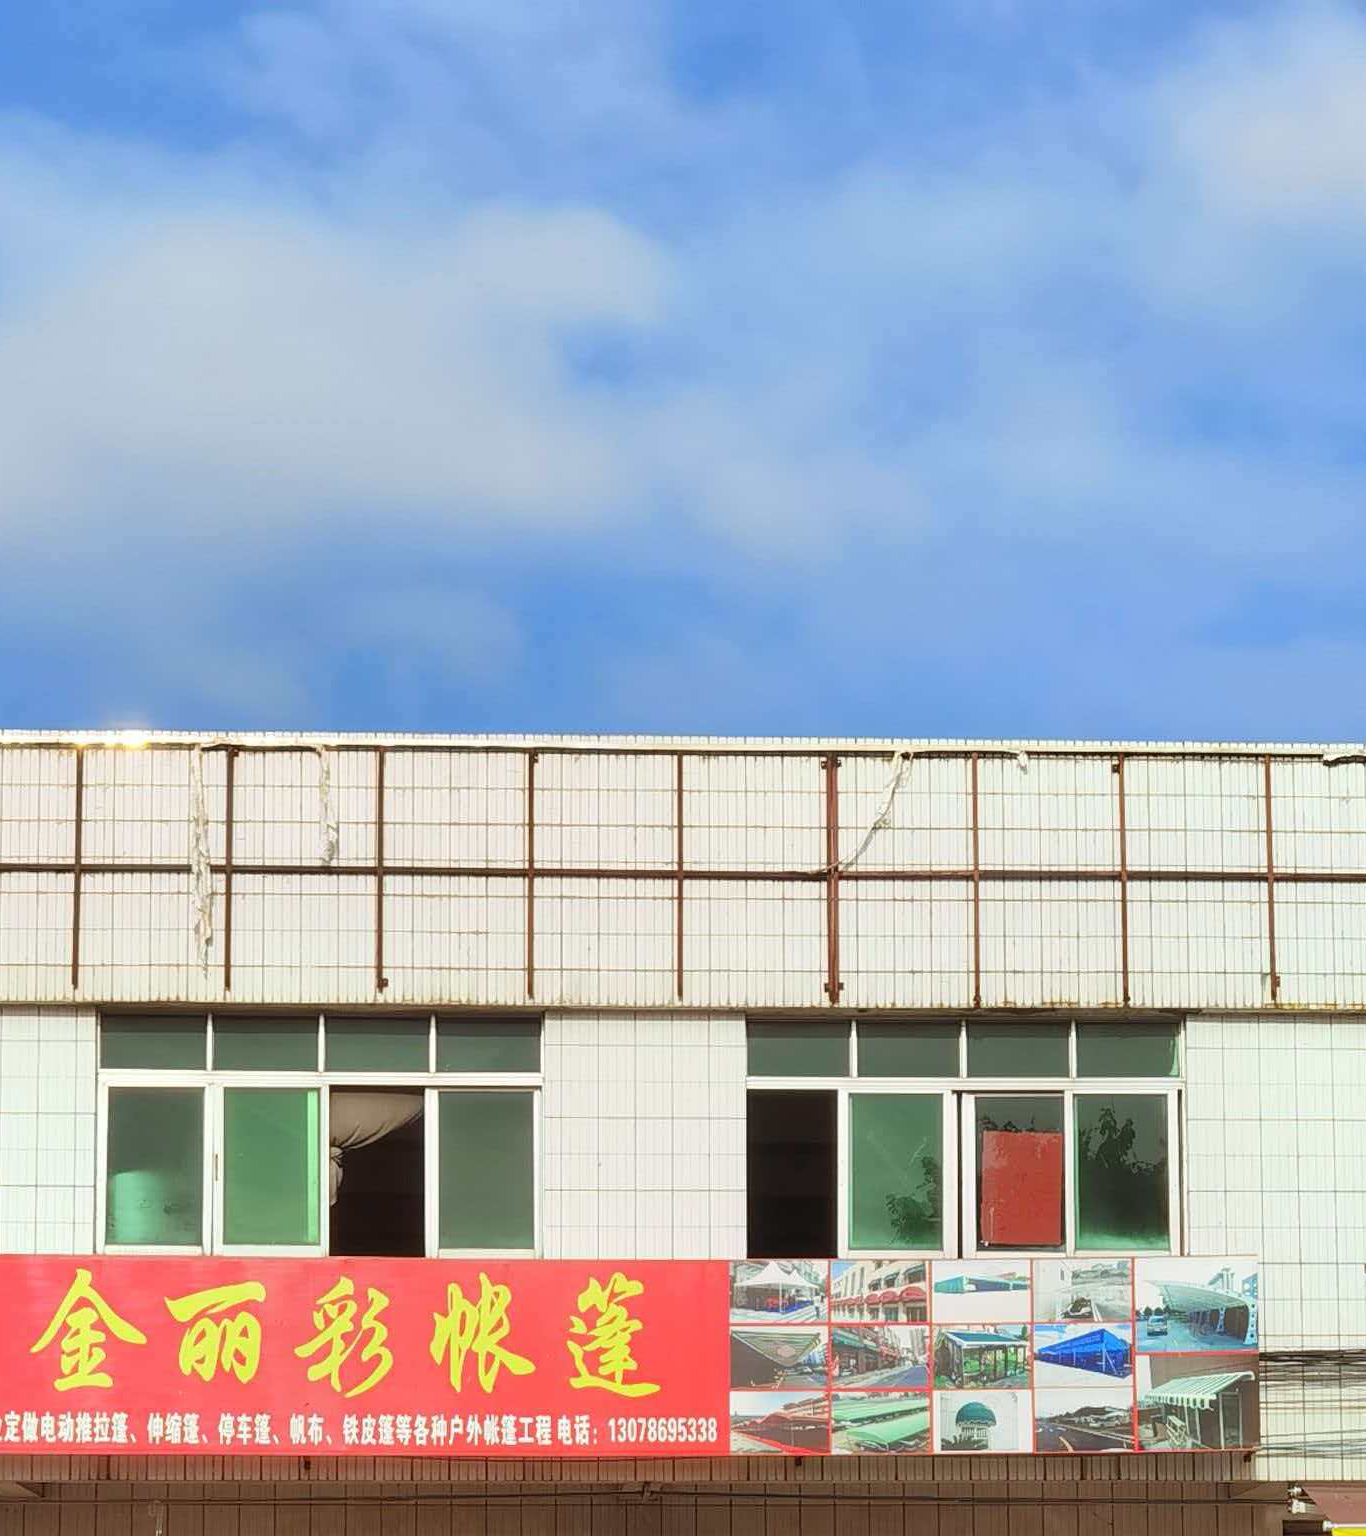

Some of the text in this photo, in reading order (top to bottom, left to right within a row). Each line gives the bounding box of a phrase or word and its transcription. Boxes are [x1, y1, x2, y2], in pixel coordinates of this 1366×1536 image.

[30, 1267, 661, 1398] 金丽彩帐篷
